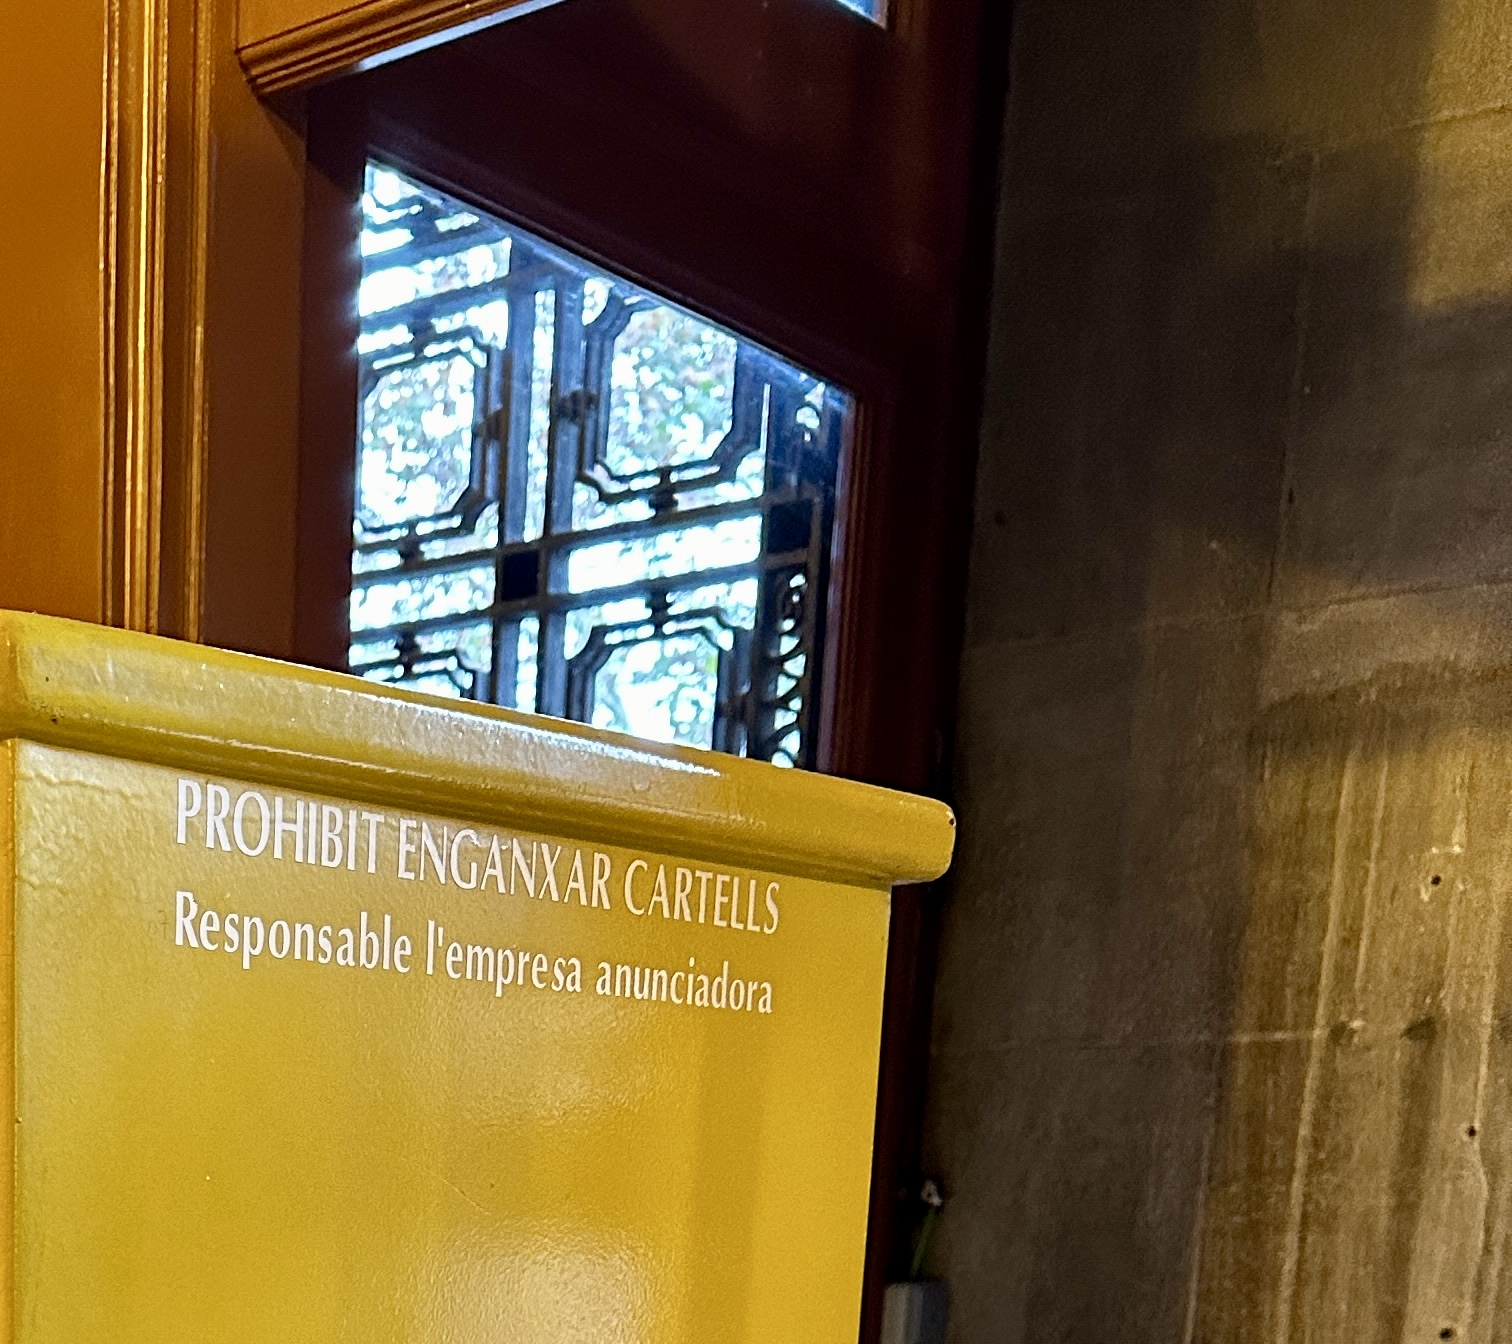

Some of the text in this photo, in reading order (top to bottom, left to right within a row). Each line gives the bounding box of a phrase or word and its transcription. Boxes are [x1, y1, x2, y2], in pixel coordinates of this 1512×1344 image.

[176, 779, 780, 935] PROHIBIT ENGANXAR CARTELLS
[174, 890, 774, 1014] Responsable l'empresa anunciadora
